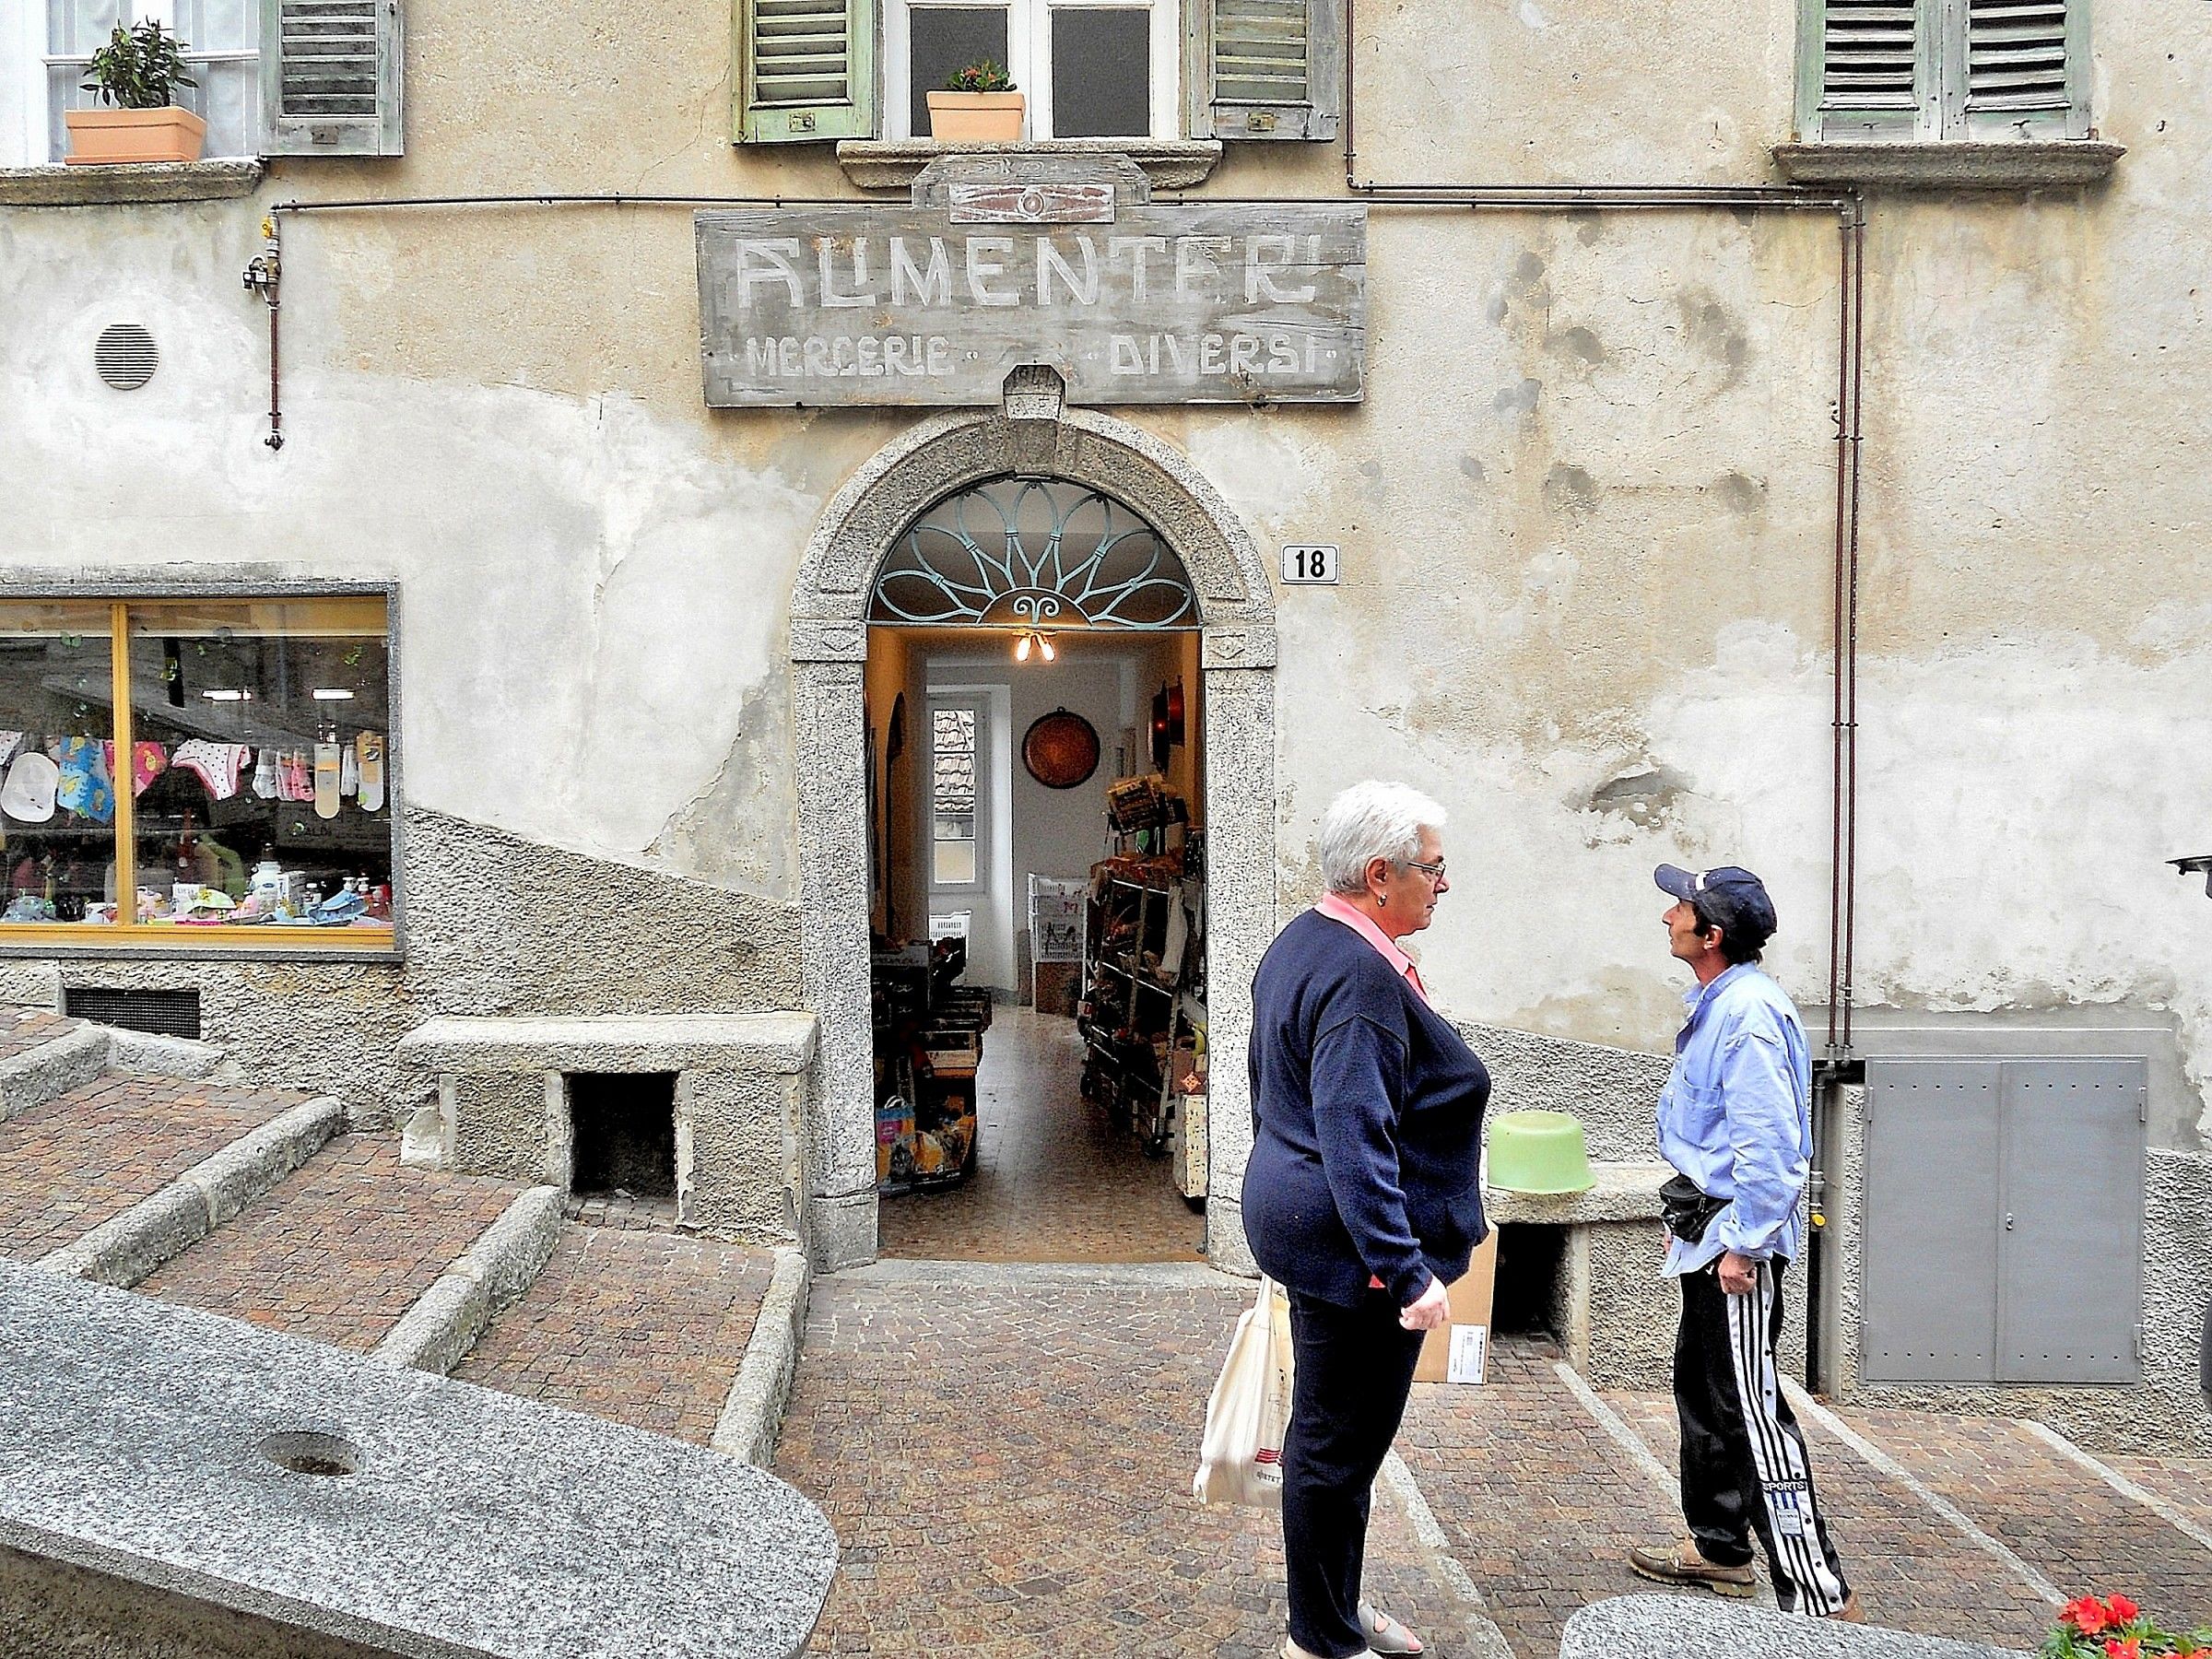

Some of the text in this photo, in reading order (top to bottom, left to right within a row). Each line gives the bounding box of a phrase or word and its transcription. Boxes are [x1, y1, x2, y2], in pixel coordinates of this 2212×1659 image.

[746, 333, 1316, 377] MERCERIE DIVERSI
[1295, 549, 1326, 578] 18
[1761, 1480, 1805, 1492] SPORTS
